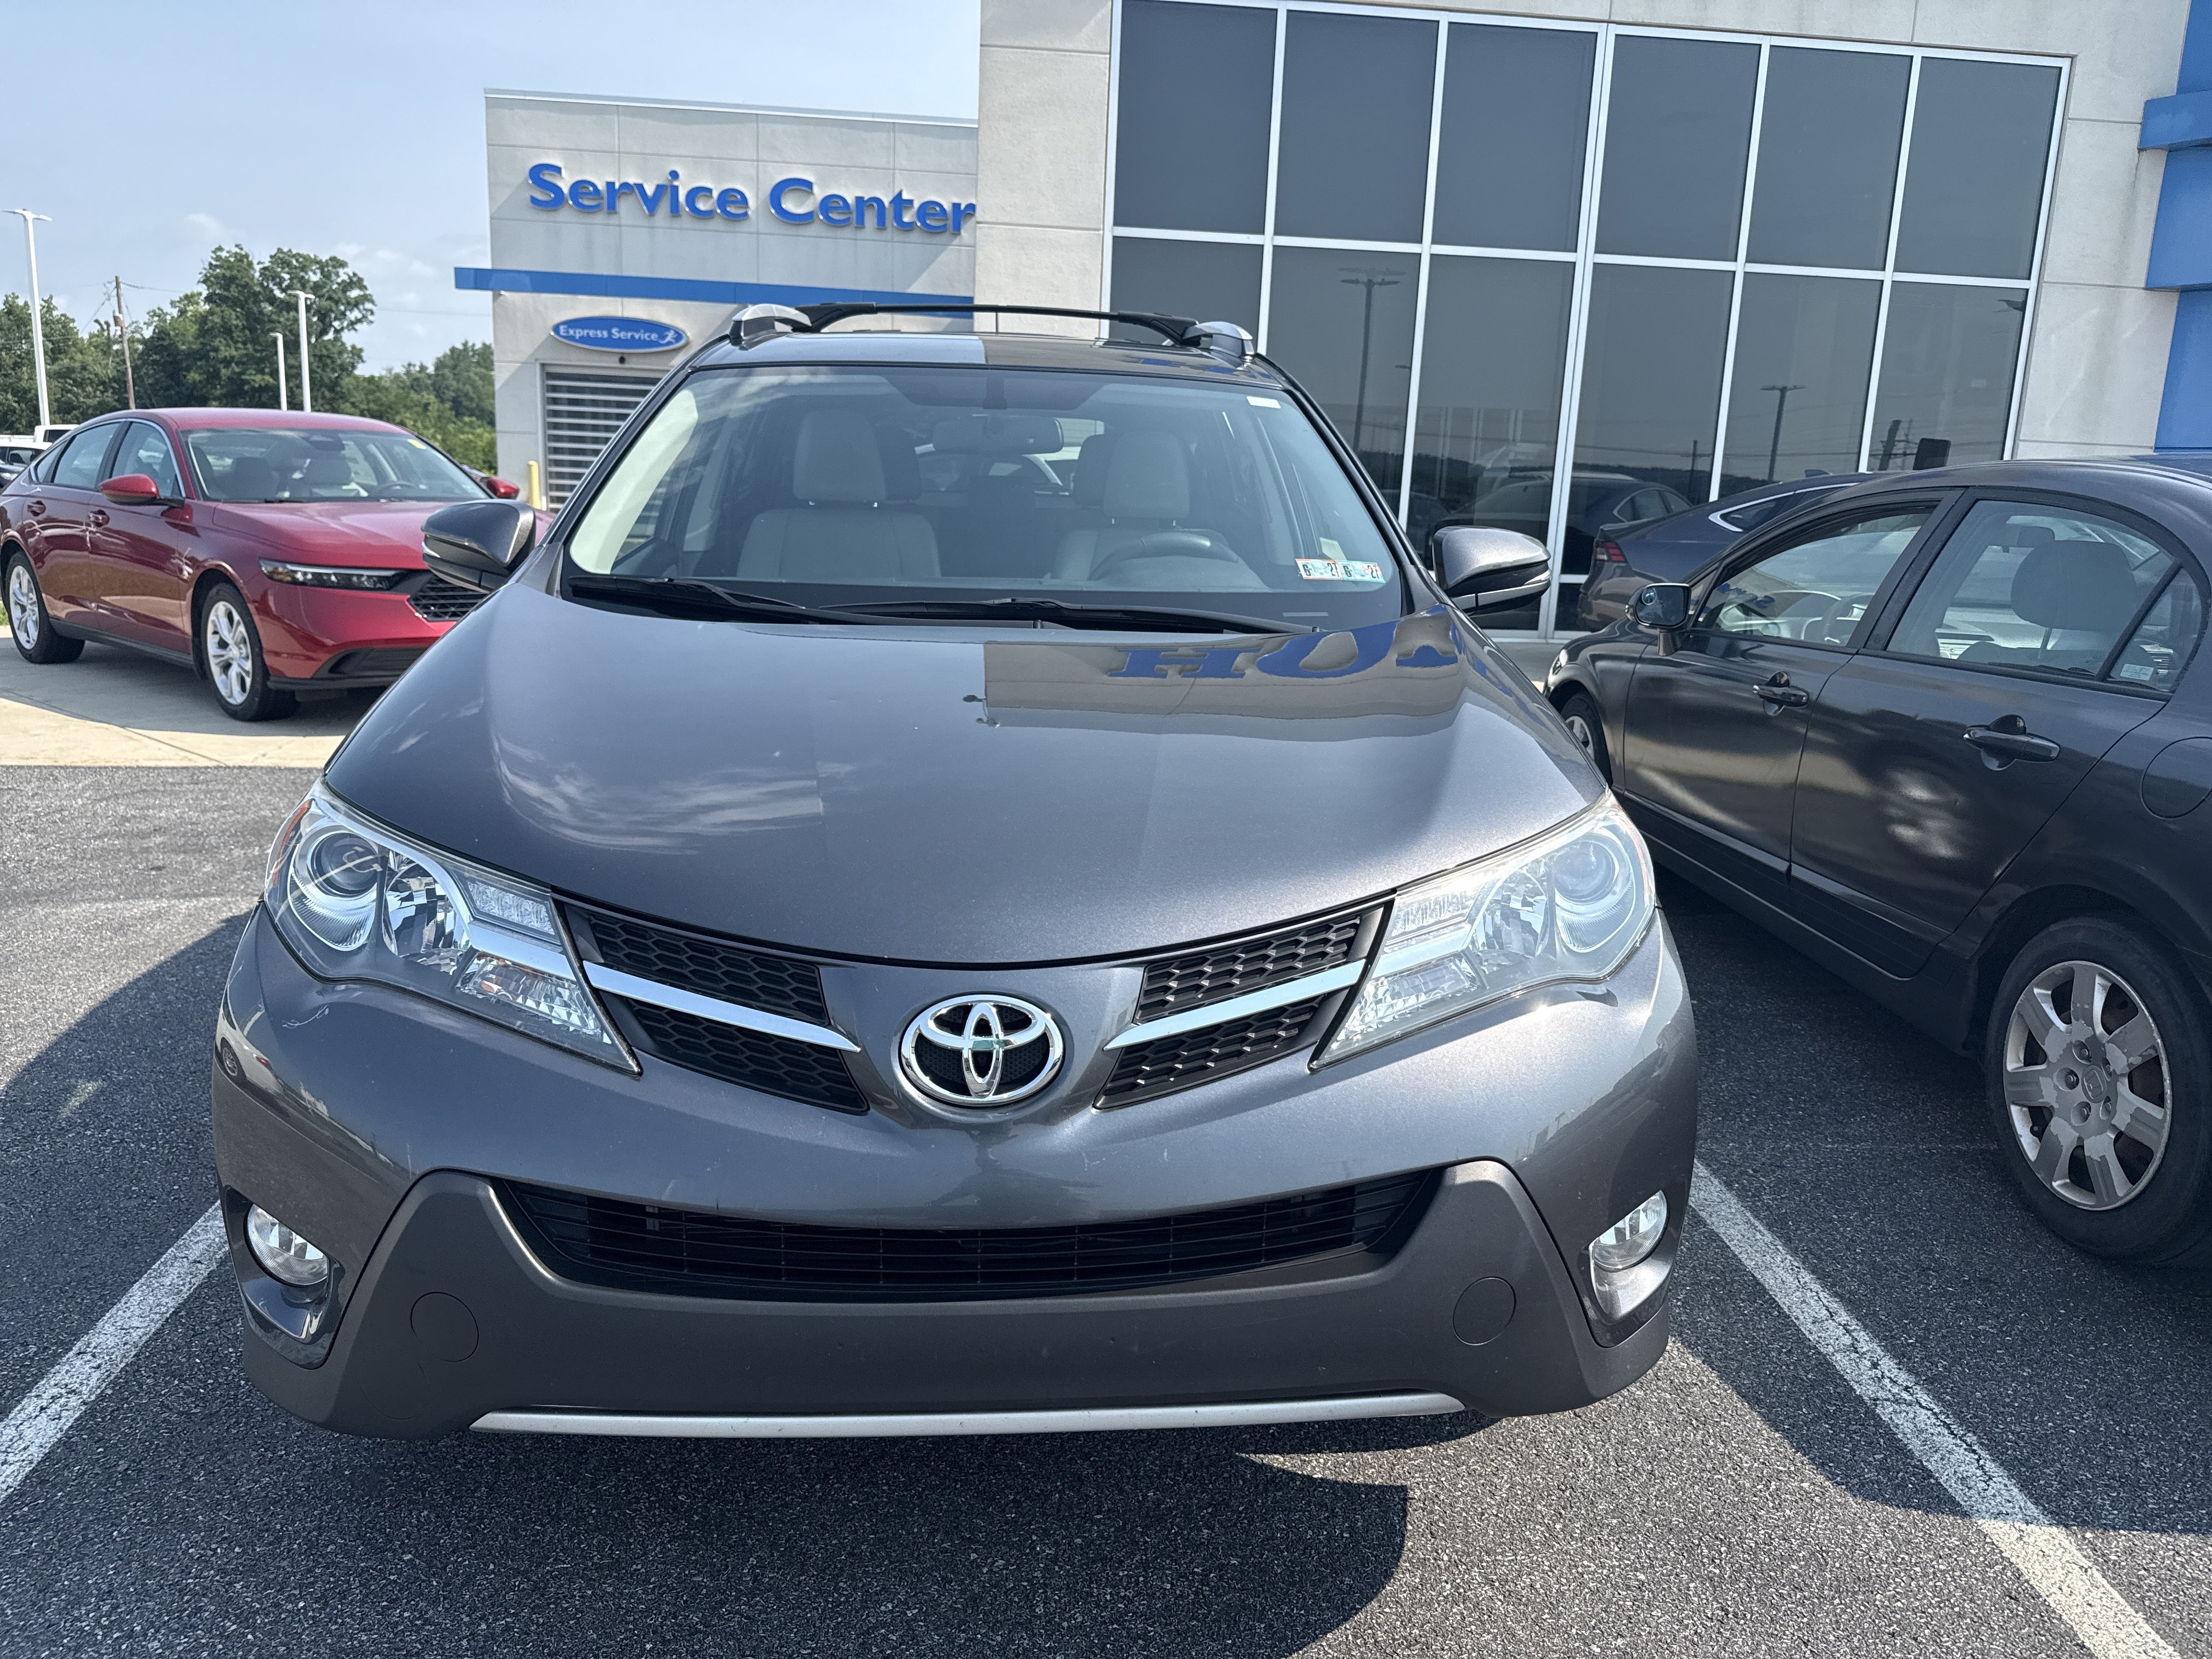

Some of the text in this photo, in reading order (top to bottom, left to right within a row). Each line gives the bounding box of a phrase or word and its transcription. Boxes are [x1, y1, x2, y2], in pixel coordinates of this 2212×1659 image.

[527, 163, 977, 235] Service Center
[558, 324, 659, 342] Express Service
[1327, 562, 1340, 578] 27
[1367, 565, 1380, 579] 27
